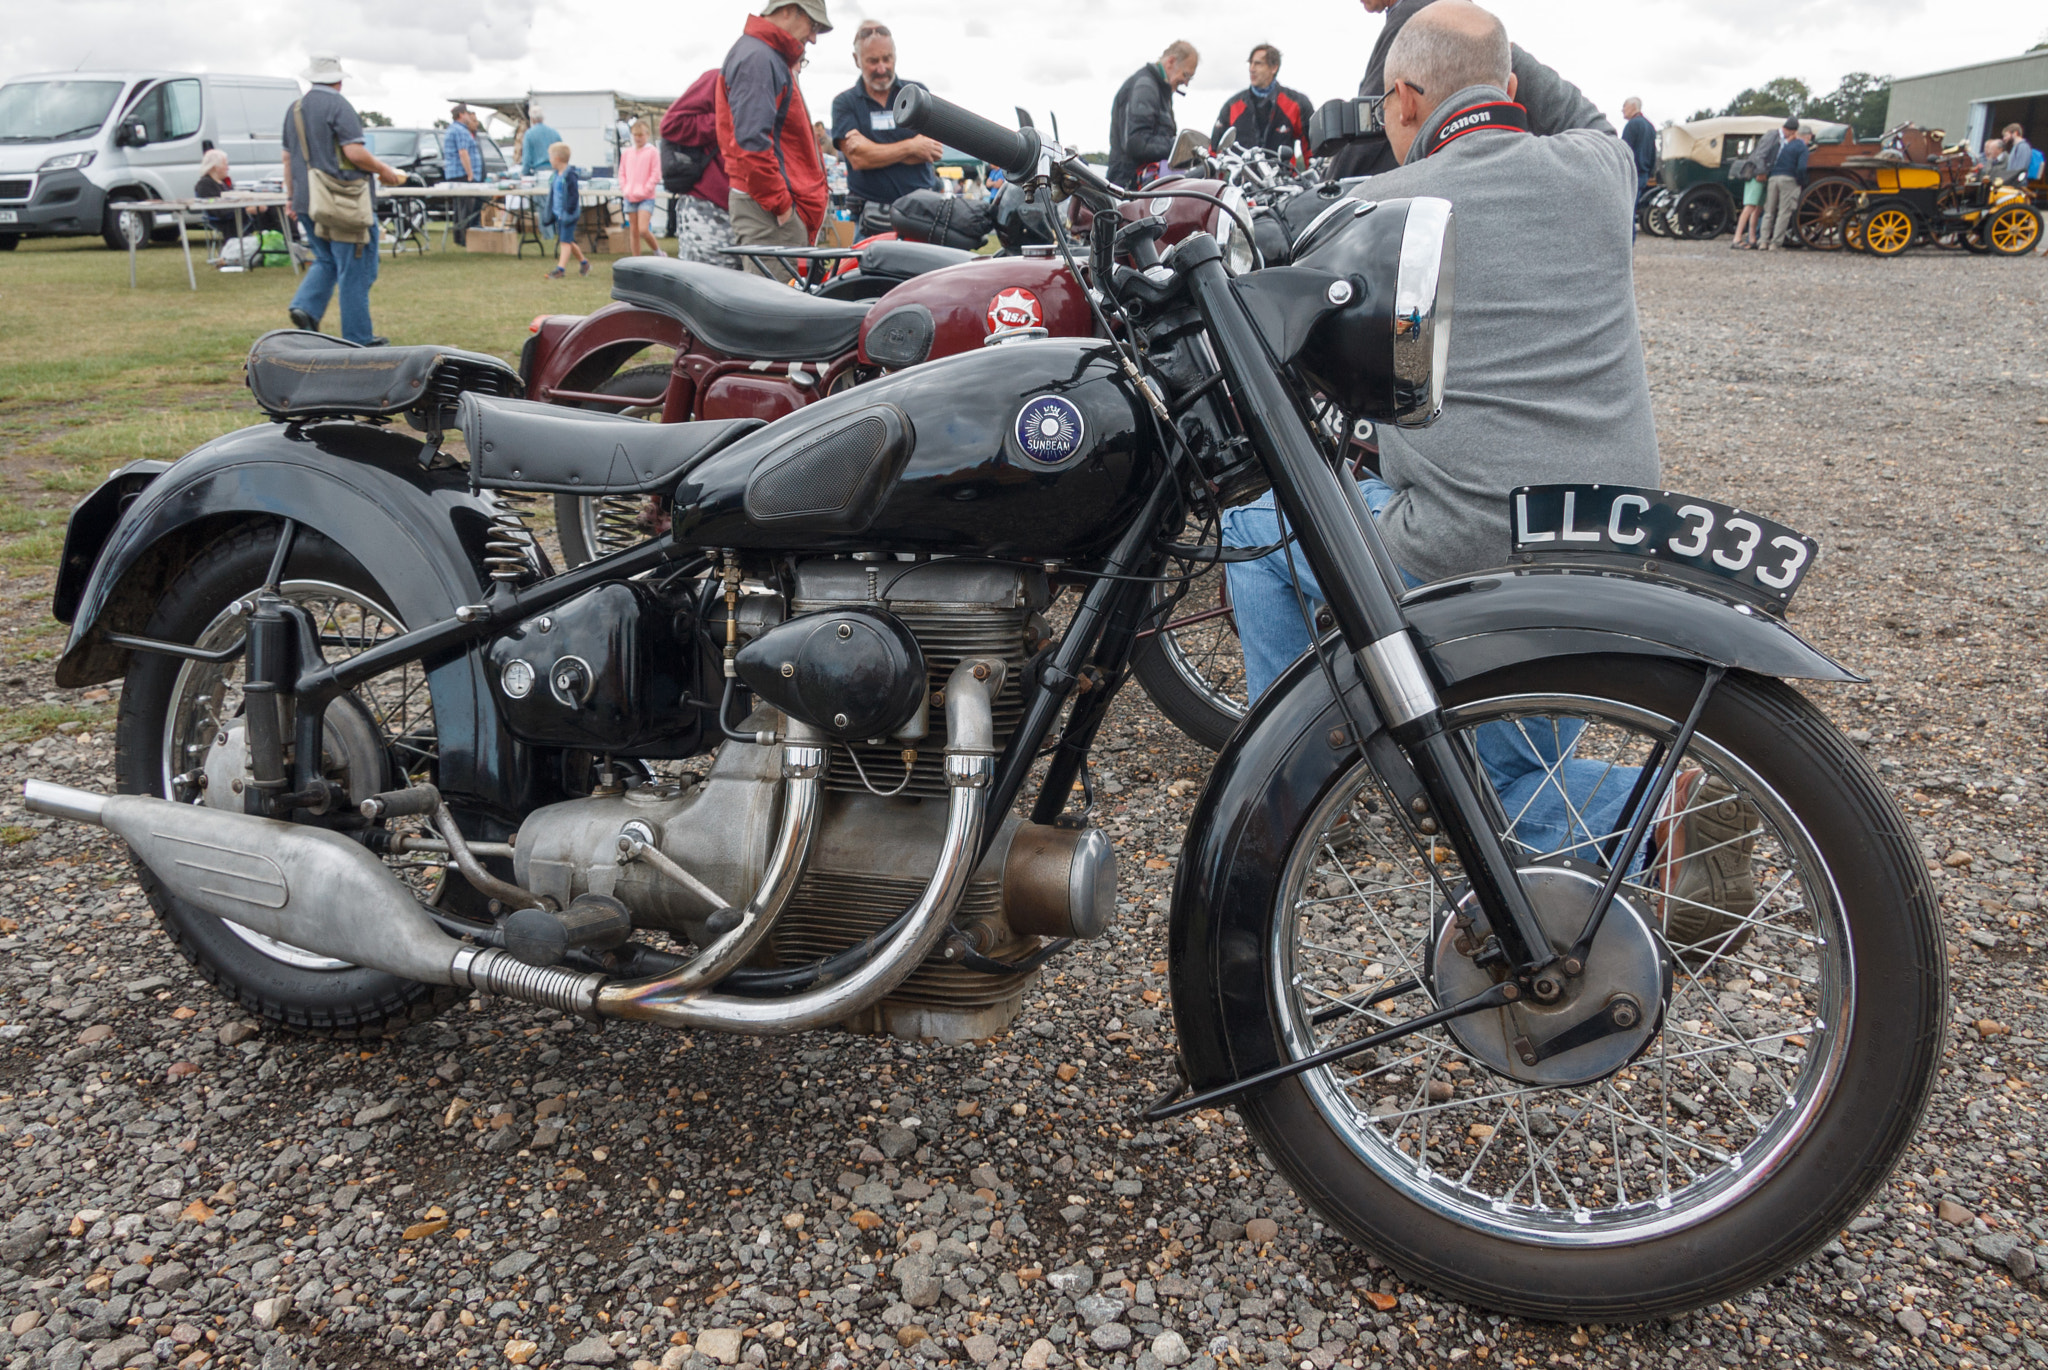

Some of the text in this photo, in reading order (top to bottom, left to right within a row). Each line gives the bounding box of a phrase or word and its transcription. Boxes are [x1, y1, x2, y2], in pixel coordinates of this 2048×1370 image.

[1440, 111, 1491, 139] Canon
[1027, 439, 1071, 451] SUNBEAM
[1516, 491, 1808, 589] LLC 333
